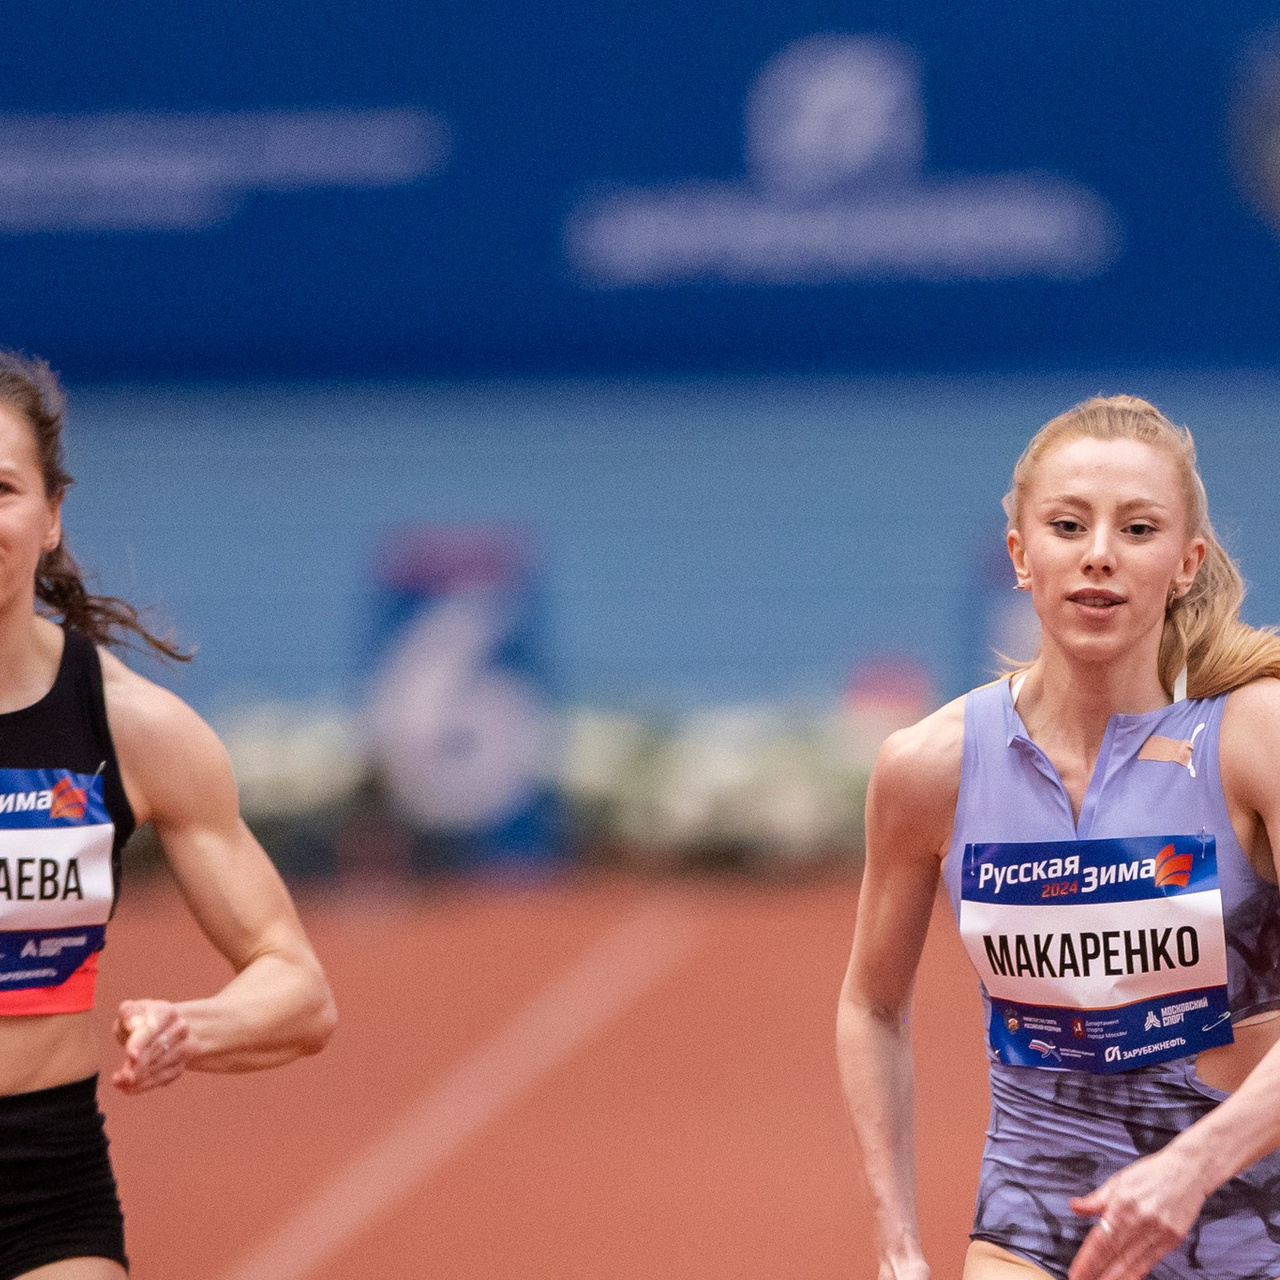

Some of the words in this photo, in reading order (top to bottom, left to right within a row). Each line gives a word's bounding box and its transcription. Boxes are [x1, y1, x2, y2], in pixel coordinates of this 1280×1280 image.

[979, 855, 1081, 894] Русская
[1081, 857, 1157, 893] Зима
[1041, 881, 1079, 898] 2024
[983, 925, 1200, 978] МАКАРЕНКО
[1161, 997, 1208, 1017] МОСКОВСКИЙ
[1162, 1012, 1184, 1027] СПОРТ
[1122, 1037, 1186, 1060] ЗАРУБЕЖНЕФТЬ
